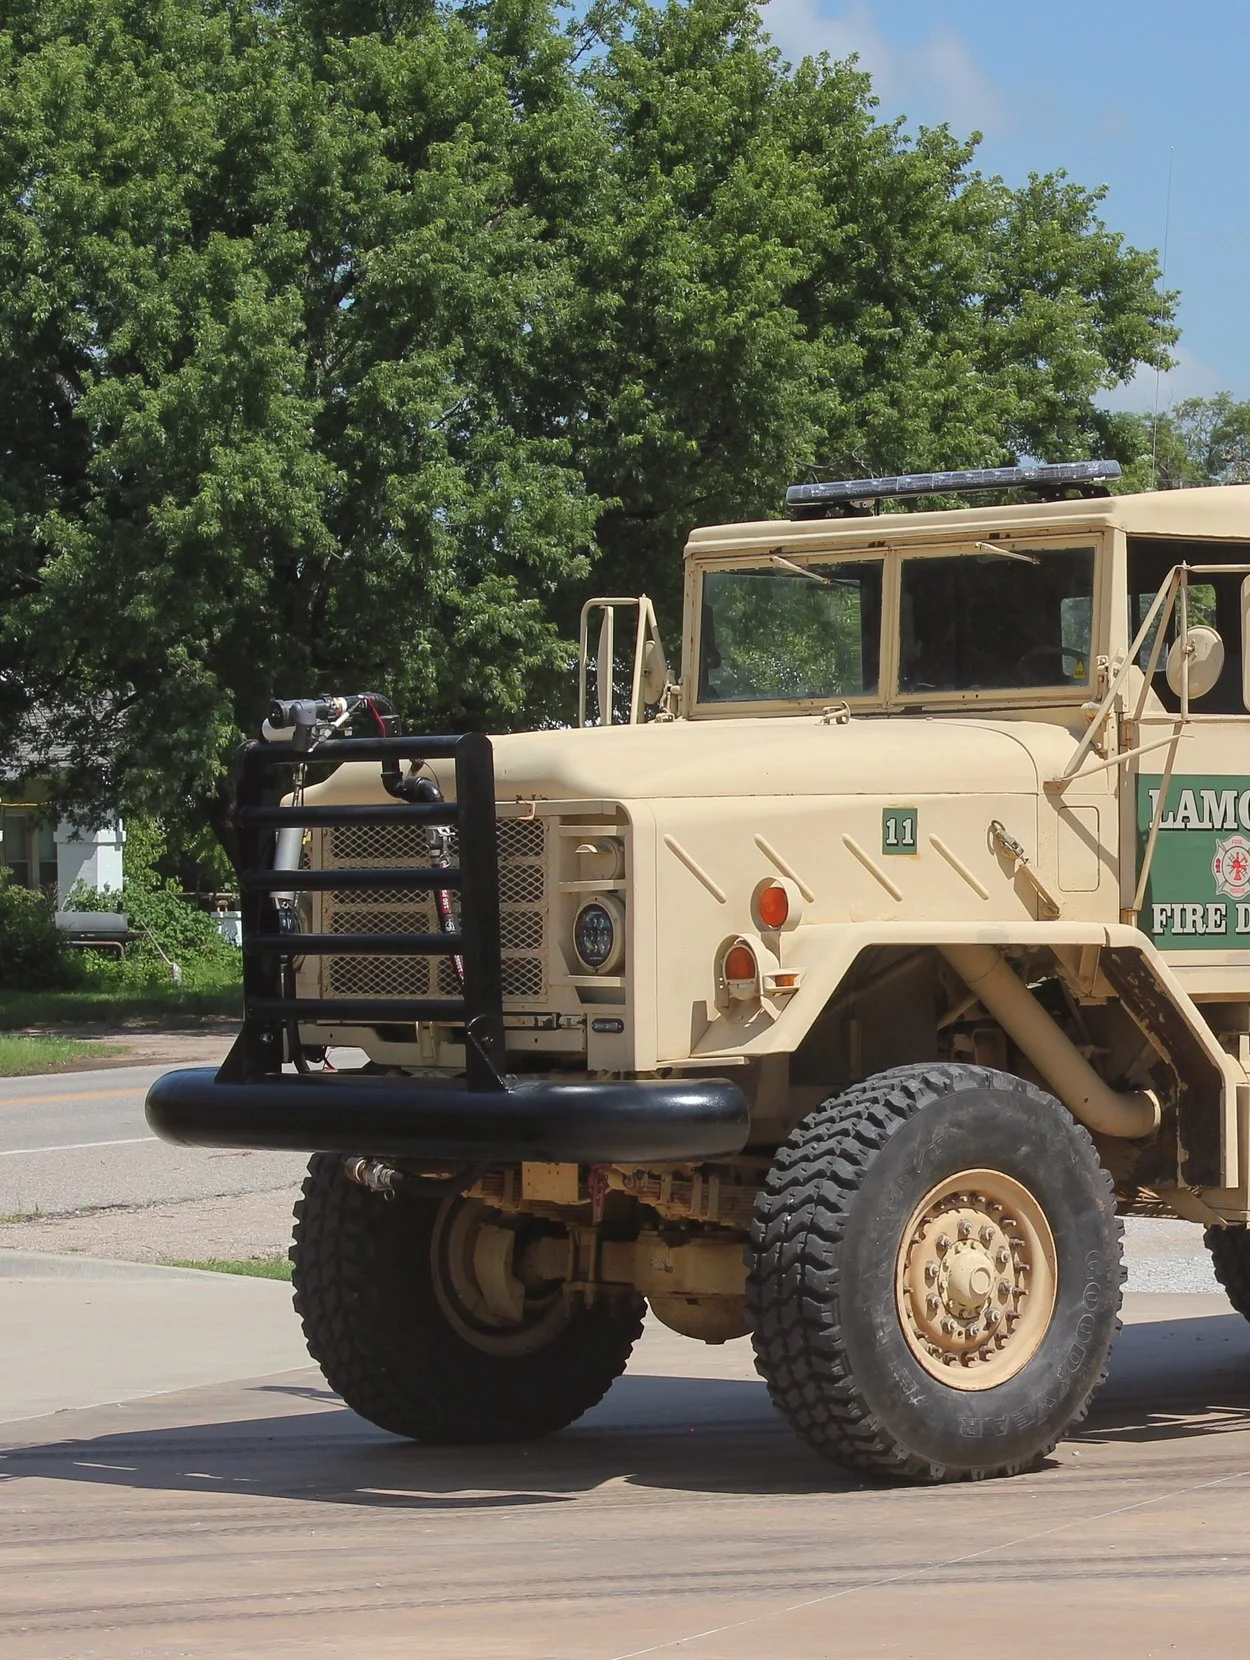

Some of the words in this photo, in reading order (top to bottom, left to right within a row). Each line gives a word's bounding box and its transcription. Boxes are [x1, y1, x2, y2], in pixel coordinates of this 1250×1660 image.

[886, 818, 915, 846] 11
[1151, 903, 1227, 935] FIRE
[958, 1249, 1101, 1438] GOODYEAR
